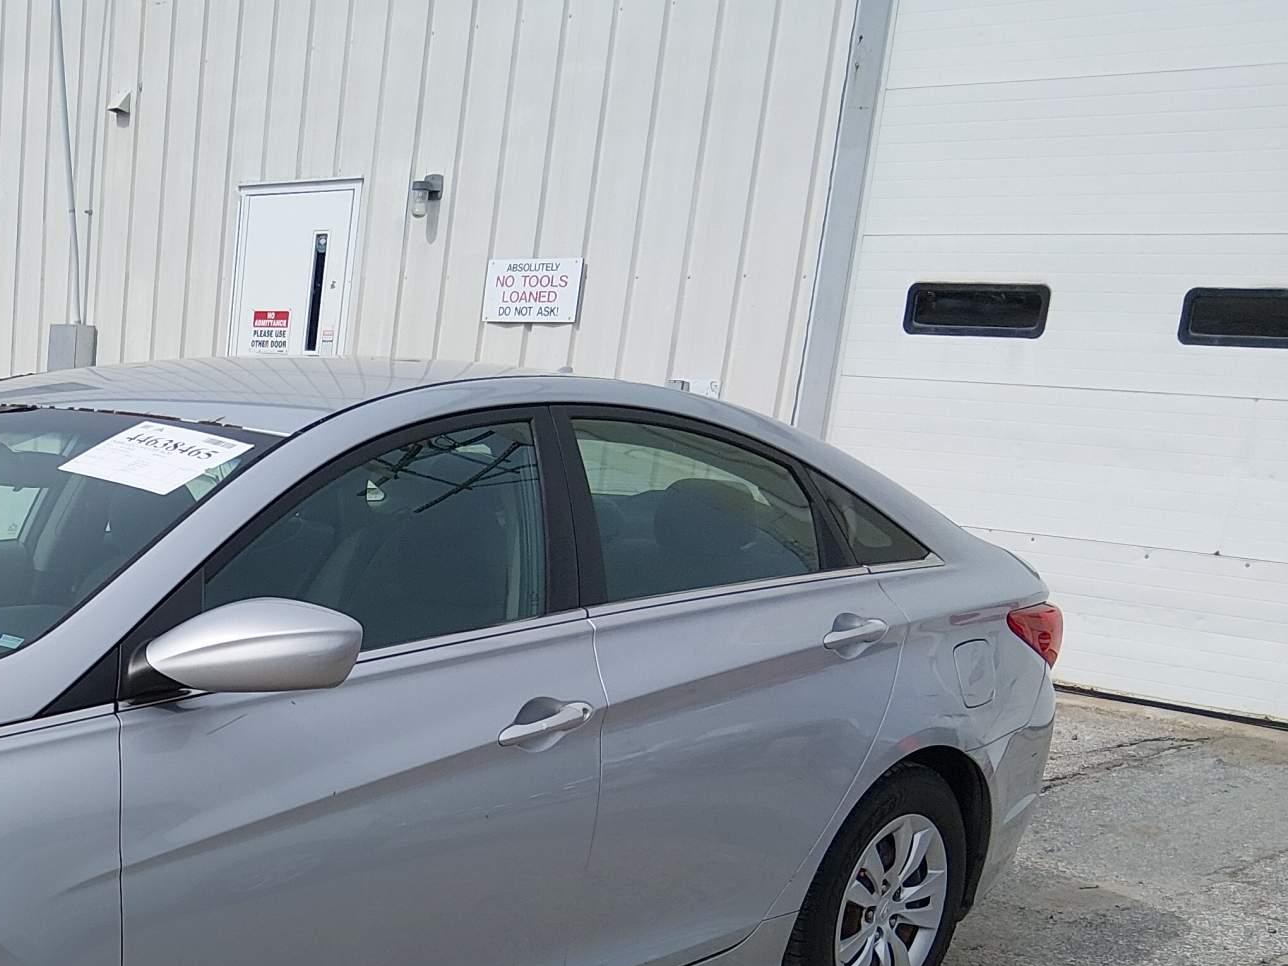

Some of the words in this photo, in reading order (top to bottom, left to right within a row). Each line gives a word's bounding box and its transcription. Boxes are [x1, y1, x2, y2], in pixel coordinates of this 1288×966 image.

[507, 262, 560, 272] ABSOLUTELY
[495, 275, 515, 288] NO
[522, 274, 569, 288] TOOLS
[502, 290, 558, 303] LOANED
[498, 306, 511, 316] DO
[514, 306, 533, 316] NOT
[537, 306, 559, 316] ASK!
[253, 330, 273, 338] PLEASE
[275, 330, 286, 338] USE
[251, 340, 269, 348] OTHER
[270, 340, 286, 348] DOOR
[126, 433, 219, 460] 44638465
